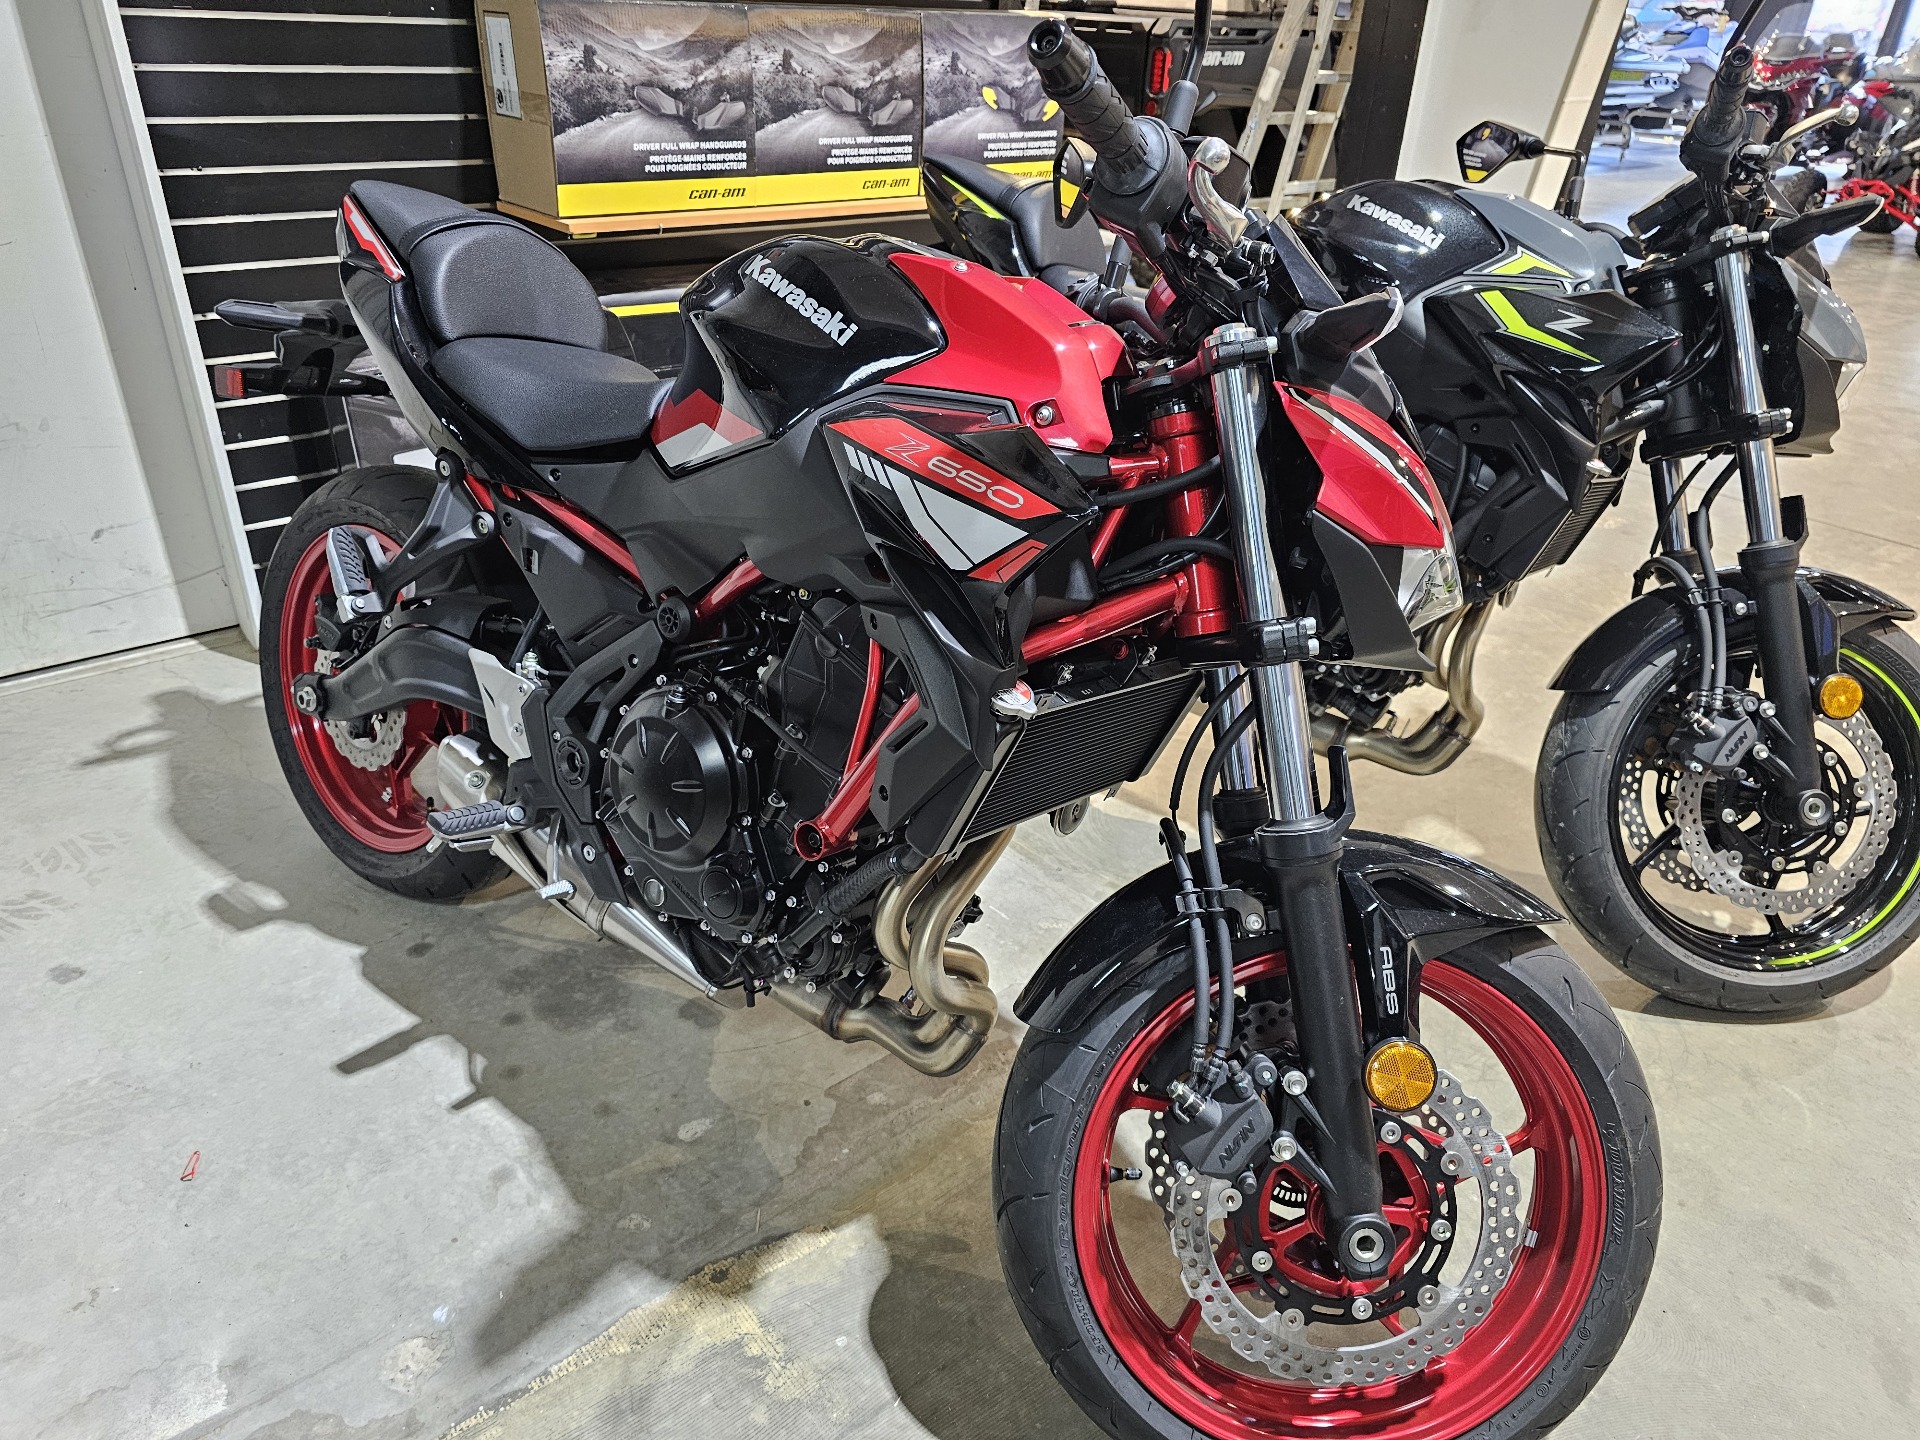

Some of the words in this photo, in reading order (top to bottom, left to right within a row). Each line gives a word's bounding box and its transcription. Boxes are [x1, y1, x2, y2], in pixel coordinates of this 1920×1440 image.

[1202, 50, 1245, 66] an-am
[633, 142, 660, 151] DRIVER
[661, 141, 678, 151] FULL
[679, 141, 700, 150] WRAP
[700, 140, 747, 149] HANDGUARDS
[819, 137, 841, 145] DRIVER
[841, 137, 856, 145] FULL
[856, 136, 873, 144] WRAP
[645, 164, 665, 173] POUR
[702, 161, 747, 171] CONDUCTEUR
[1013, 170, 1052, 179] an-am
[862, 178, 910, 190] can-am
[688, 187, 747, 199] can-am
[1346, 194, 1446, 250] Kawasaki
[745, 254, 859, 347] Kawasaki
[884, 432, 931, 468] Z
[927, 456, 1024, 509] 650
[1380, 946, 1399, 1015] ABS
